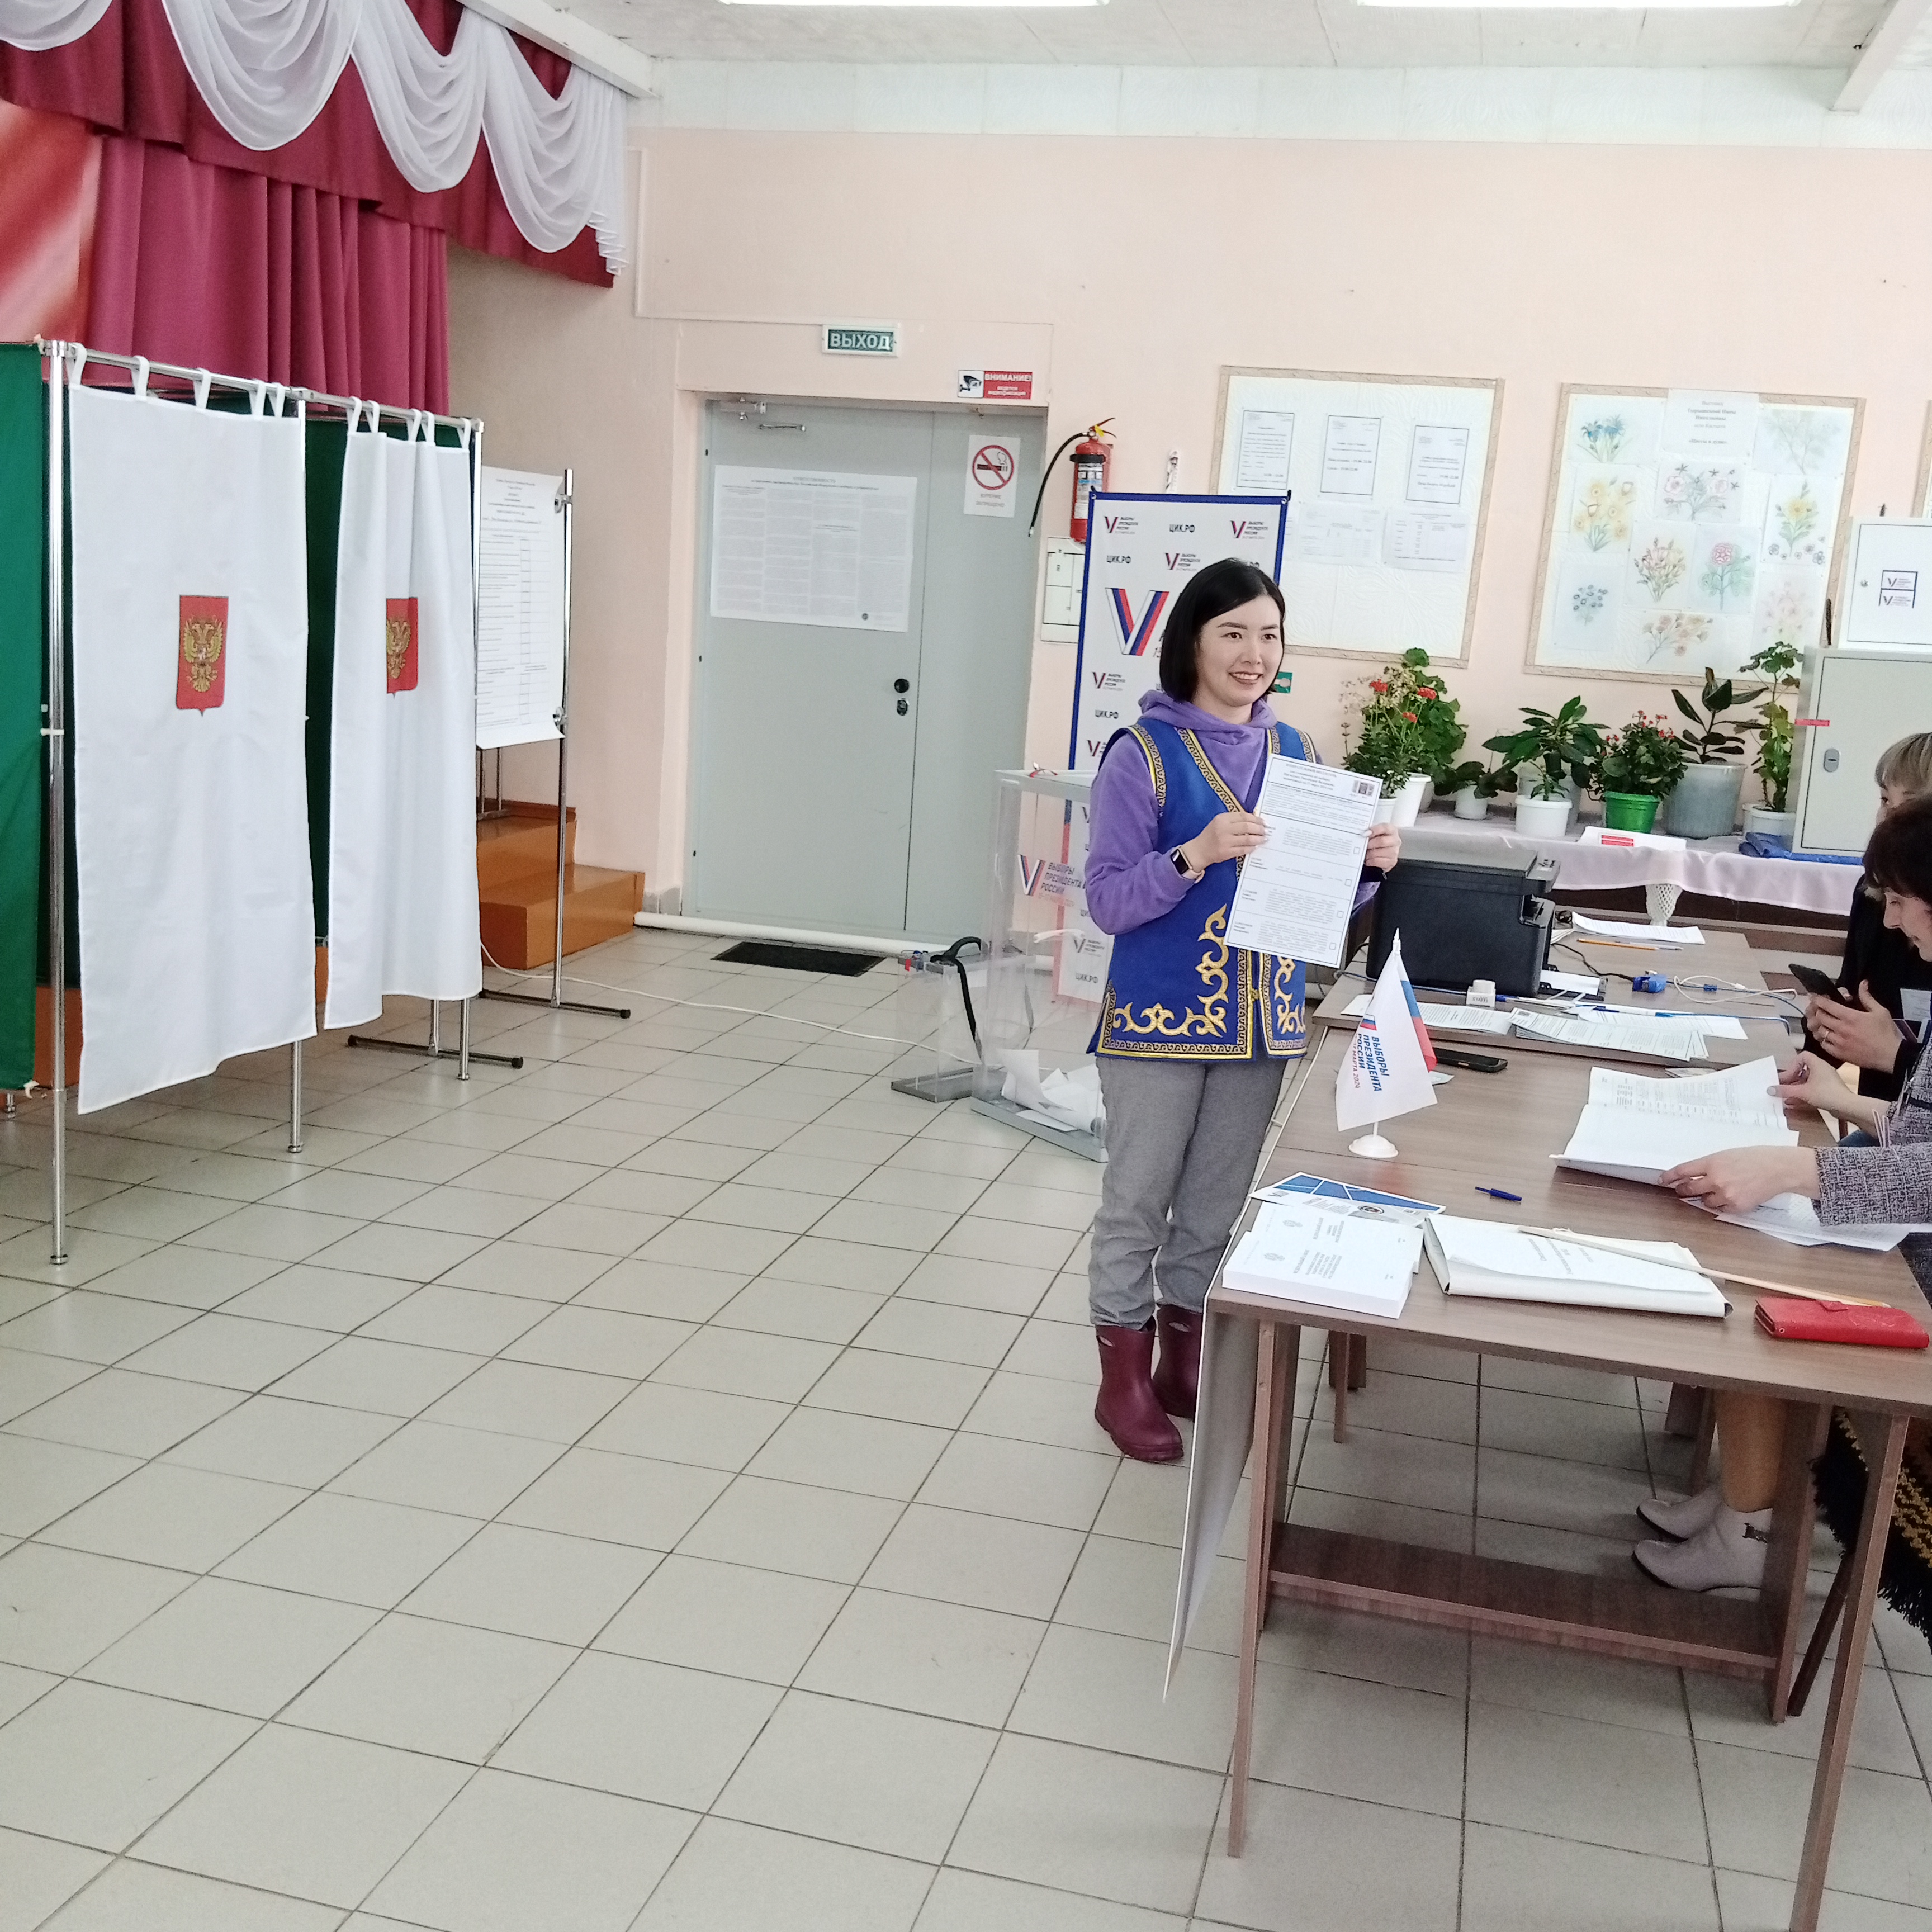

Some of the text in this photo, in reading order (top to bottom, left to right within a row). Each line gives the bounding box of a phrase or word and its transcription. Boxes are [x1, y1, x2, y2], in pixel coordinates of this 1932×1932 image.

[830, 333, 891, 350] ВЫХОД
[985, 373, 1032, 382] ВНИМАНИЕ!
[1169, 524, 1195, 533] ЦИК.РФ
[1048, 862, 1076, 875] ВЫБОРЫ
[1044, 872, 1081, 888] ПРЕЗИДЕНТА
[1041, 882, 1066, 894] РОССИИ
[1363, 1034, 1382, 1091] ПРЕЗИДЕНТА
[1371, 1036, 1390, 1076] ВЫБОРЫ
